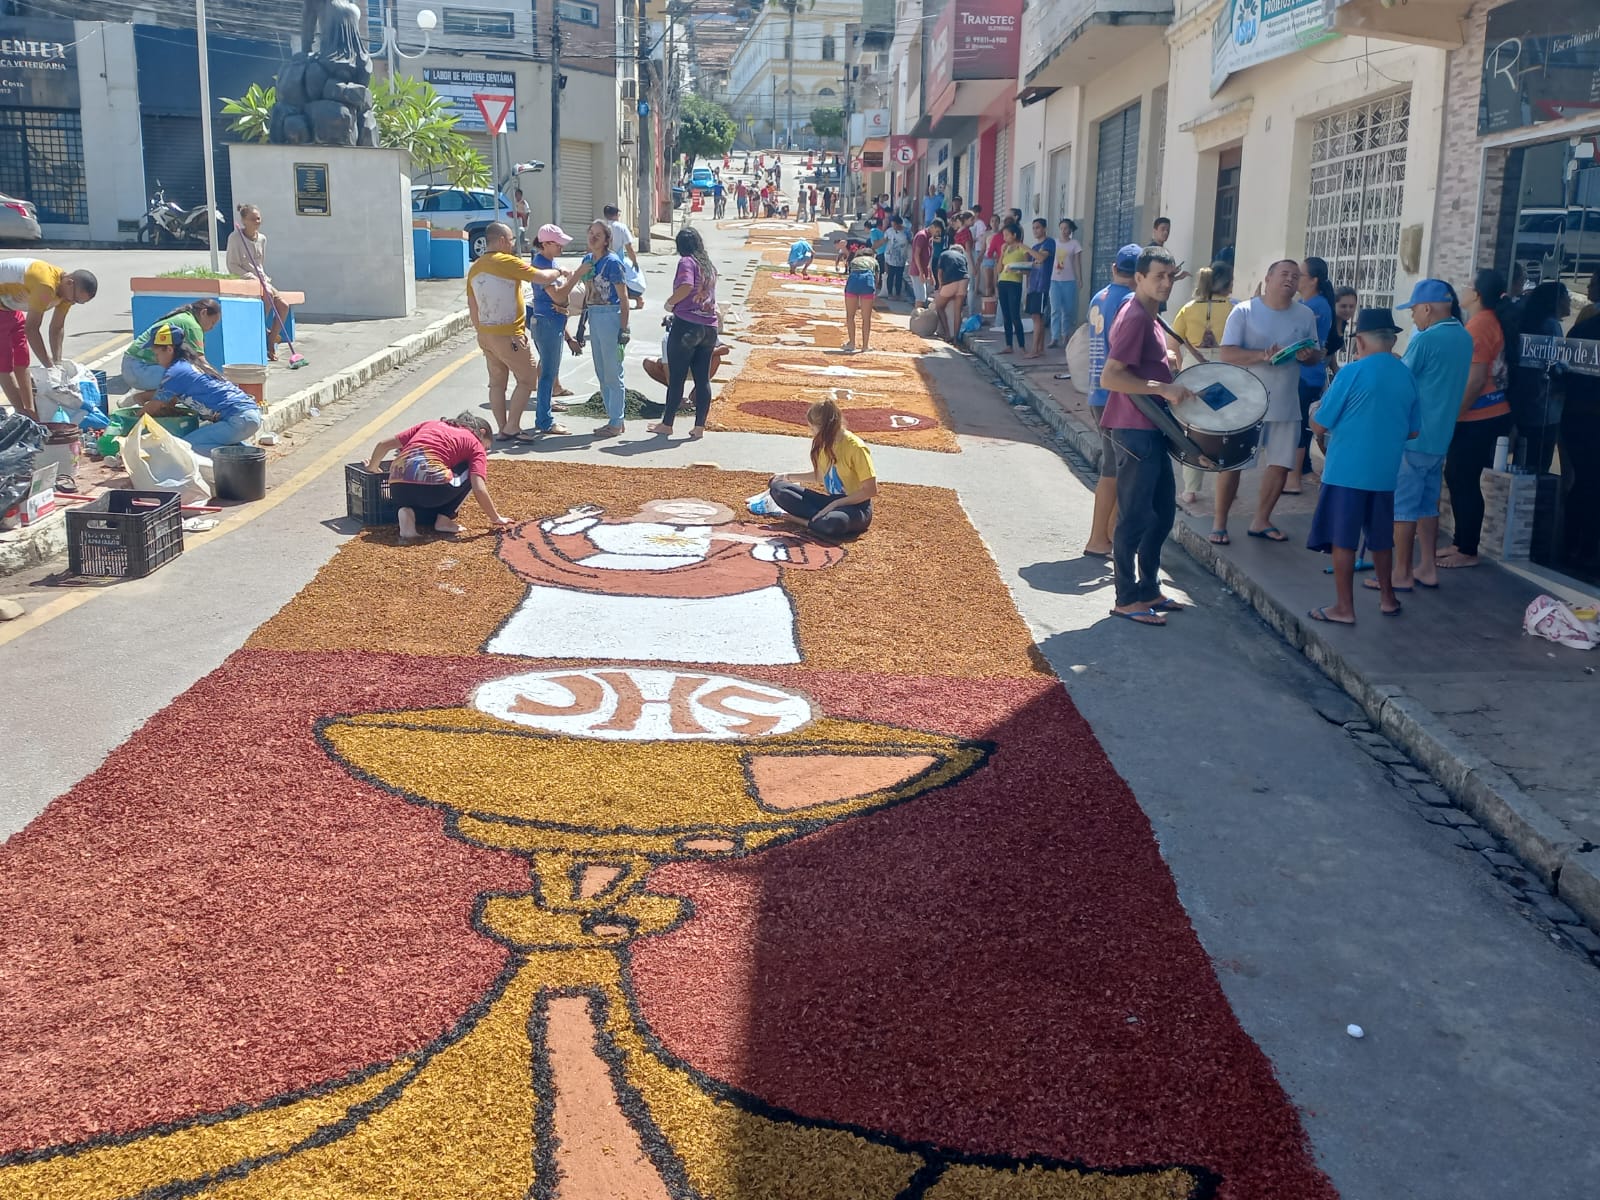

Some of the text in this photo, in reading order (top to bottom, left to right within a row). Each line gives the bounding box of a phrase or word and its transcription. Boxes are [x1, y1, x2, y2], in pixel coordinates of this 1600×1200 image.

[453, 71, 460, 81] DE
[461, 70, 485, 82] PRÓTESE
[486, 72, 514, 85] DENTÁRIA
[1574, 342, 1588, 364] de
